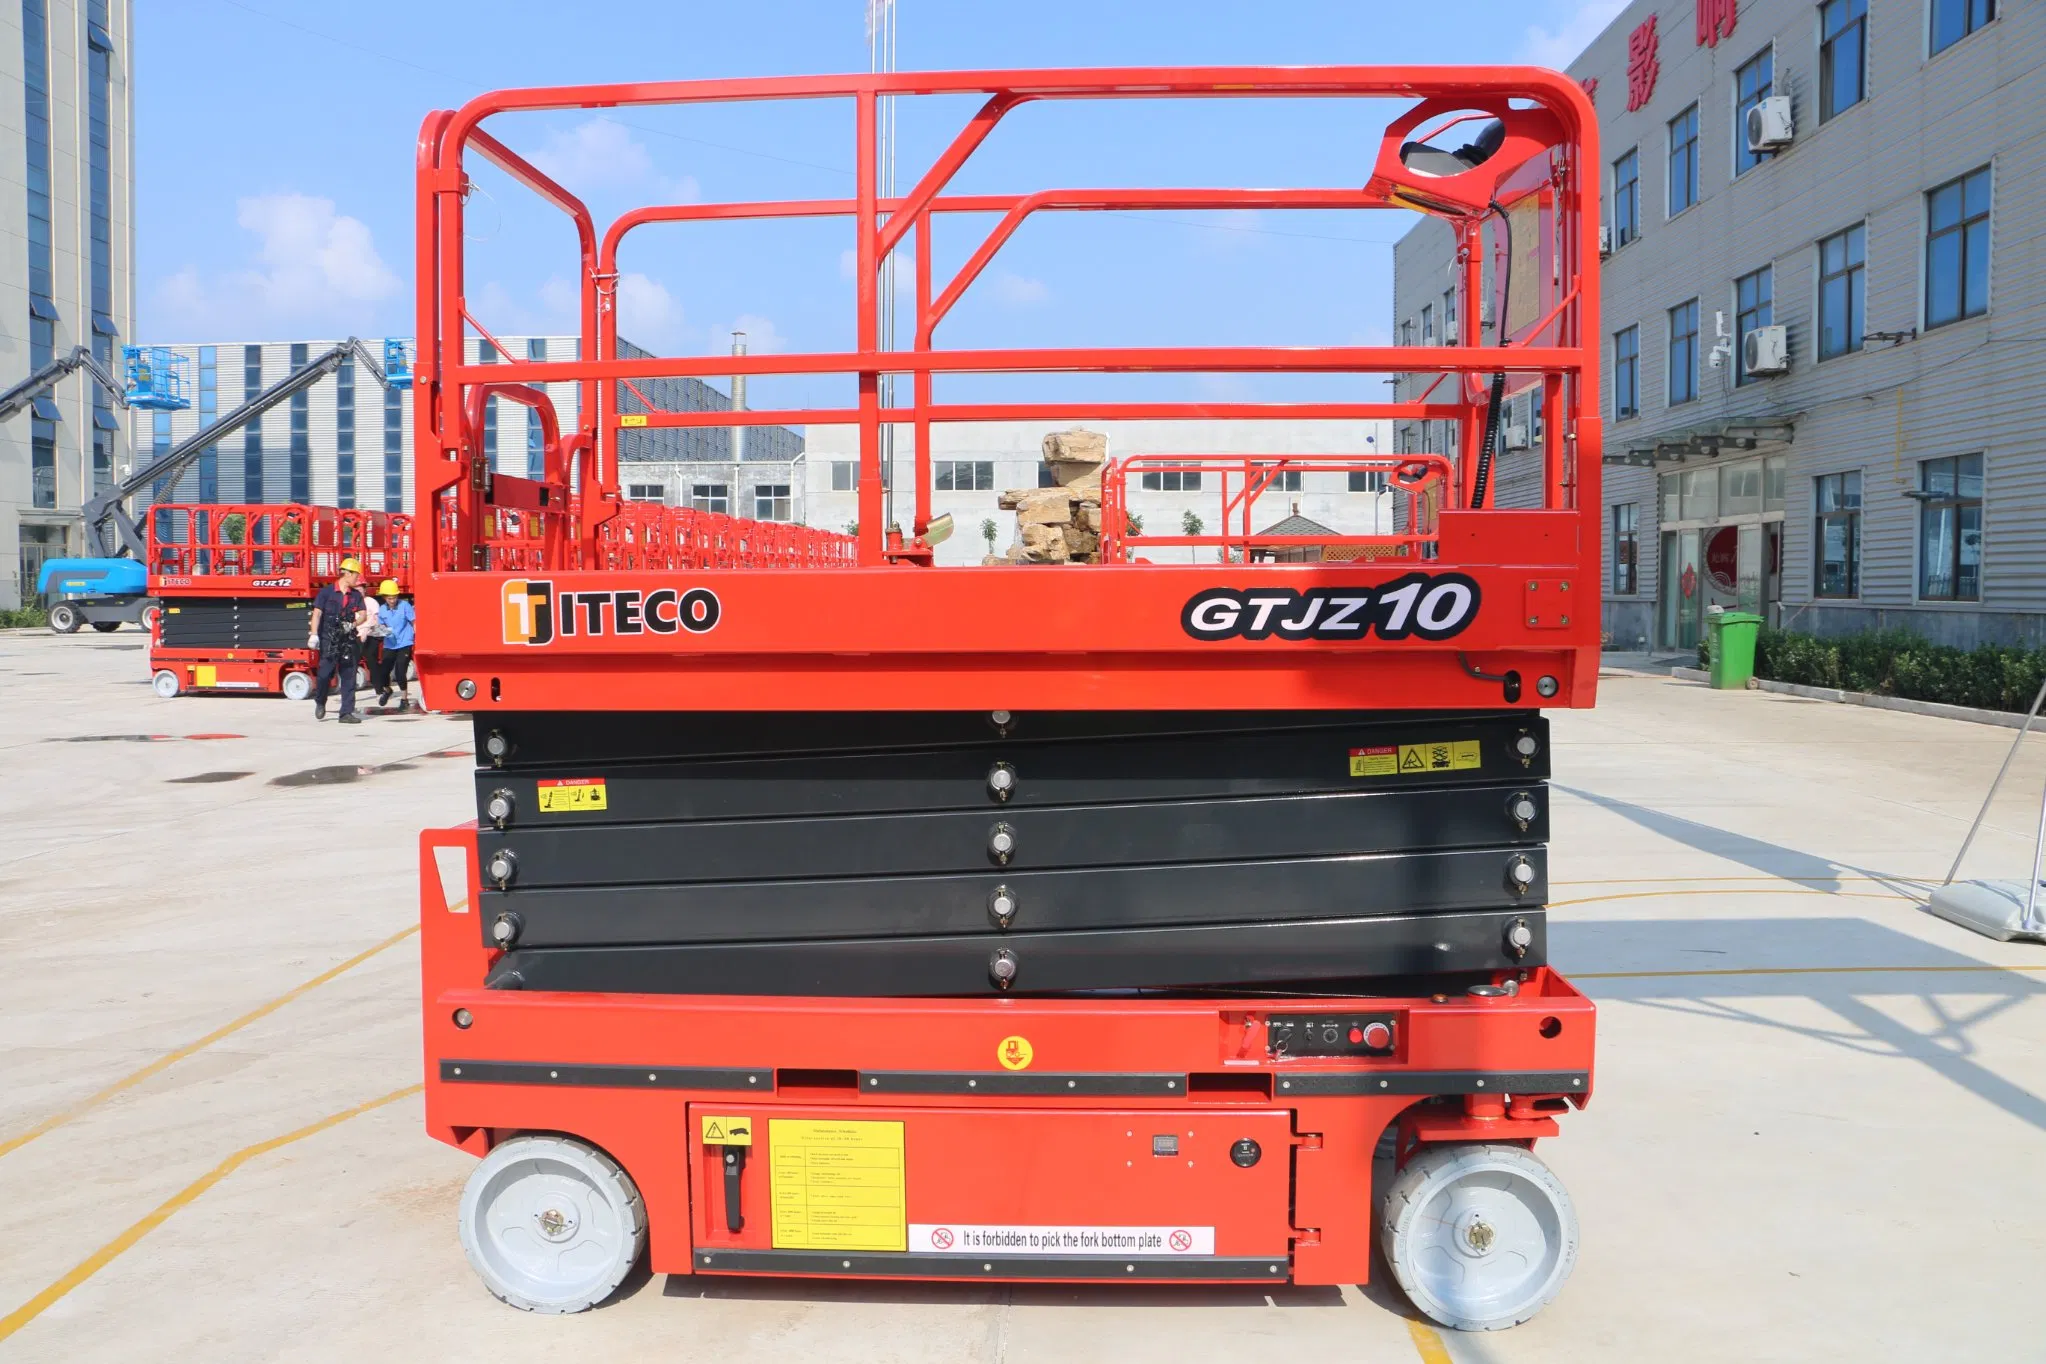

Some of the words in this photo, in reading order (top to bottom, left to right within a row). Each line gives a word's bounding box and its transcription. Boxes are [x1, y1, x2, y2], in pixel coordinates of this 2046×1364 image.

[1366, 747, 1392, 755] DANGER
[963, 1231, 970, 1246] It
[972, 1231, 981, 1246] is
[982, 1231, 1028, 1247] forbidden
[1029, 1232, 1040, 1247] to
[1041, 1232, 1061, 1250] pick
[1063, 1232, 1079, 1248] the
[1080, 1232, 1099, 1248] fork
[1101, 1232, 1137, 1248] bottom
[1138, 1232, 1162, 1250] plate
